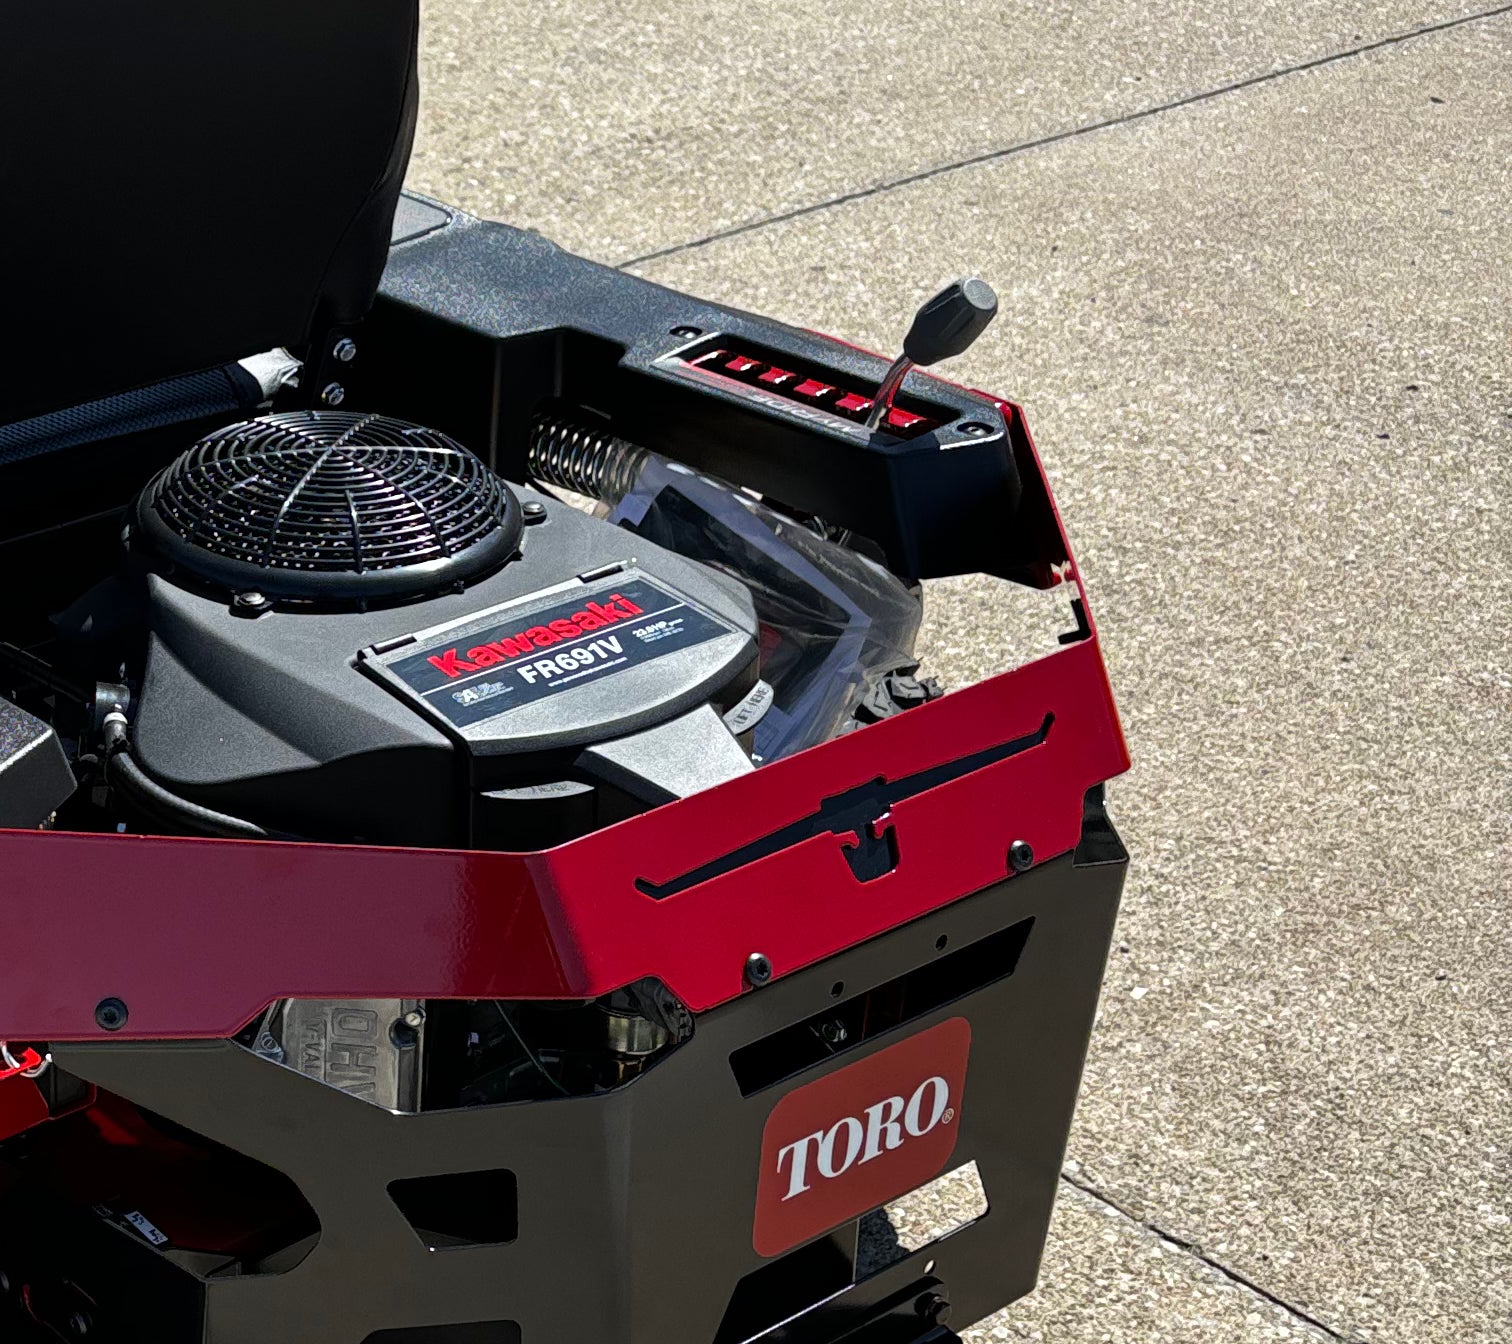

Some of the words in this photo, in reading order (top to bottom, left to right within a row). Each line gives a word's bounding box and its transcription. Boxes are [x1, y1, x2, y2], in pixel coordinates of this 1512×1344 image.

[426, 593, 644, 678] Kawasaki
[516, 635, 625, 684] FR691V
[777, 1076, 950, 1201] TORO
